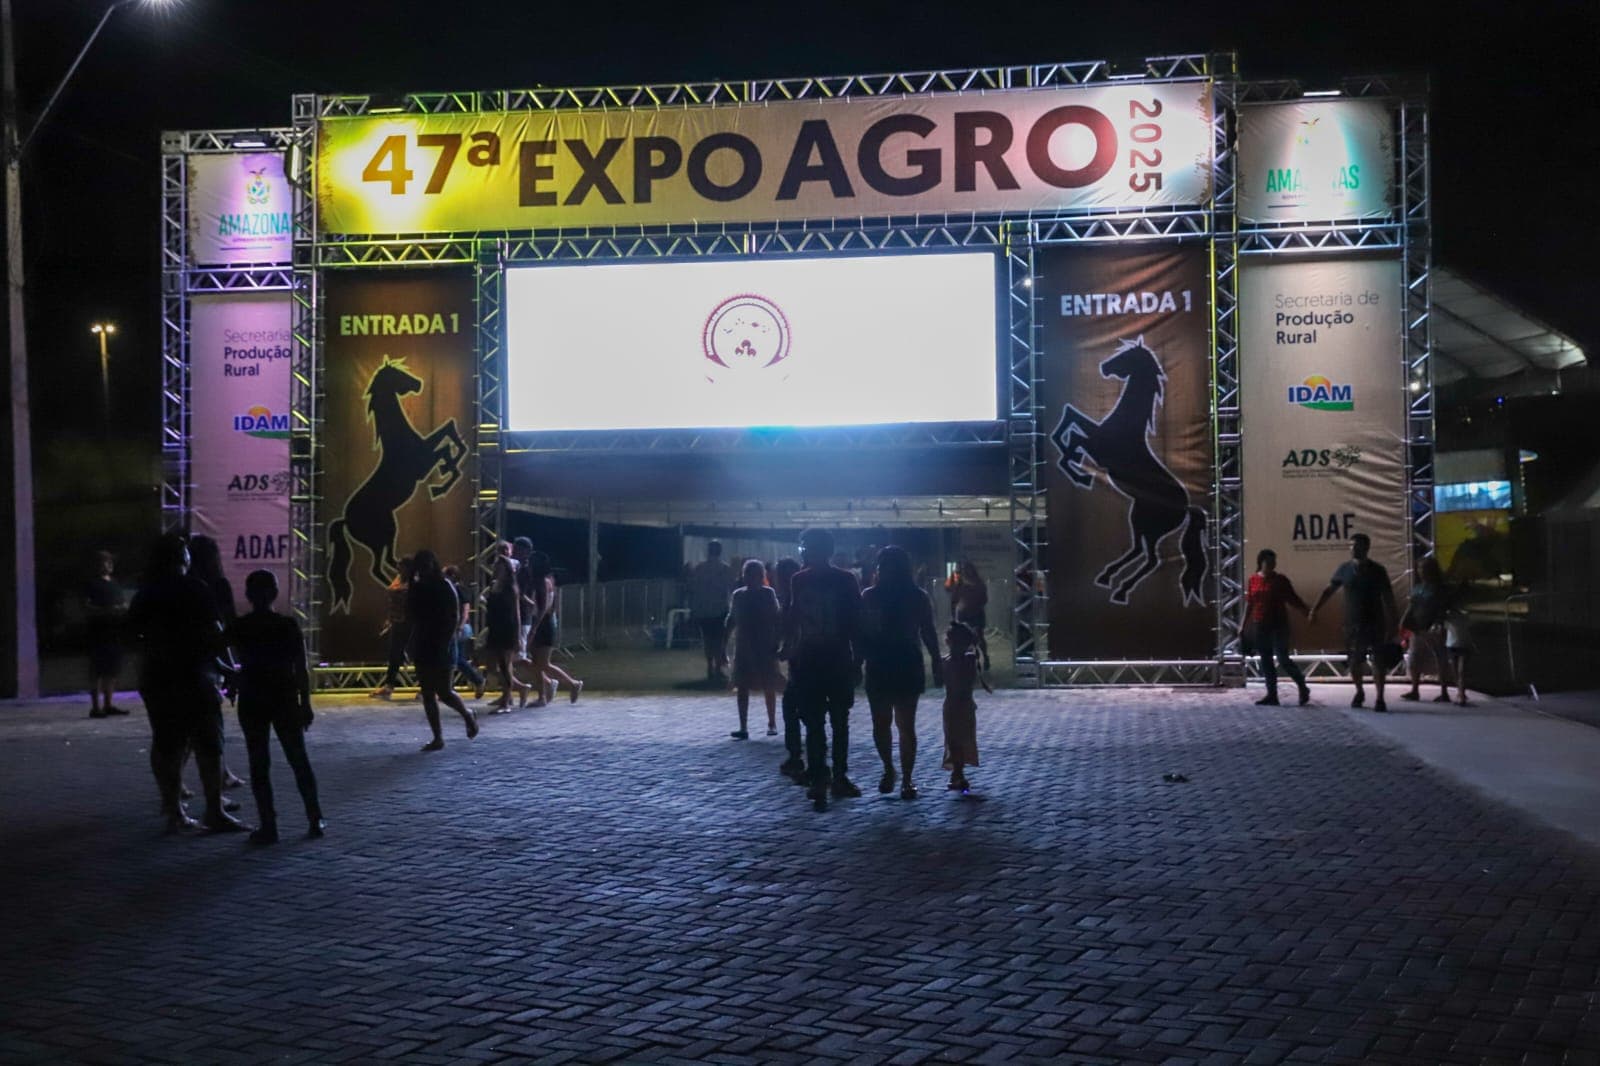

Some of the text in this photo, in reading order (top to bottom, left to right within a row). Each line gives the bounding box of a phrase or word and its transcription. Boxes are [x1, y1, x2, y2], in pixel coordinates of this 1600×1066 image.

[1129, 98, 1162, 193] 2025
[1265, 164, 1360, 193] AMAAS
[1060, 290, 1192, 316] ENTRADA 1
[1275, 290, 1380, 309] Secretaria de
[340, 313, 459, 336] ENTRADA 1
[1276, 310, 1354, 329] Produção
[224, 328, 290, 343] Secretaria
[1276, 330, 1317, 345] Rural
[224, 345, 292, 362] Produção
[224, 363, 259, 376] Rural
[1288, 385, 1352, 403] IDAM
[234, 415, 288, 431] IDAM
[1282, 449, 1330, 467] ADS
[227, 474, 269, 491] ADS
[1293, 513, 1355, 540] ADAF
[234, 534, 289, 559] ADAF
